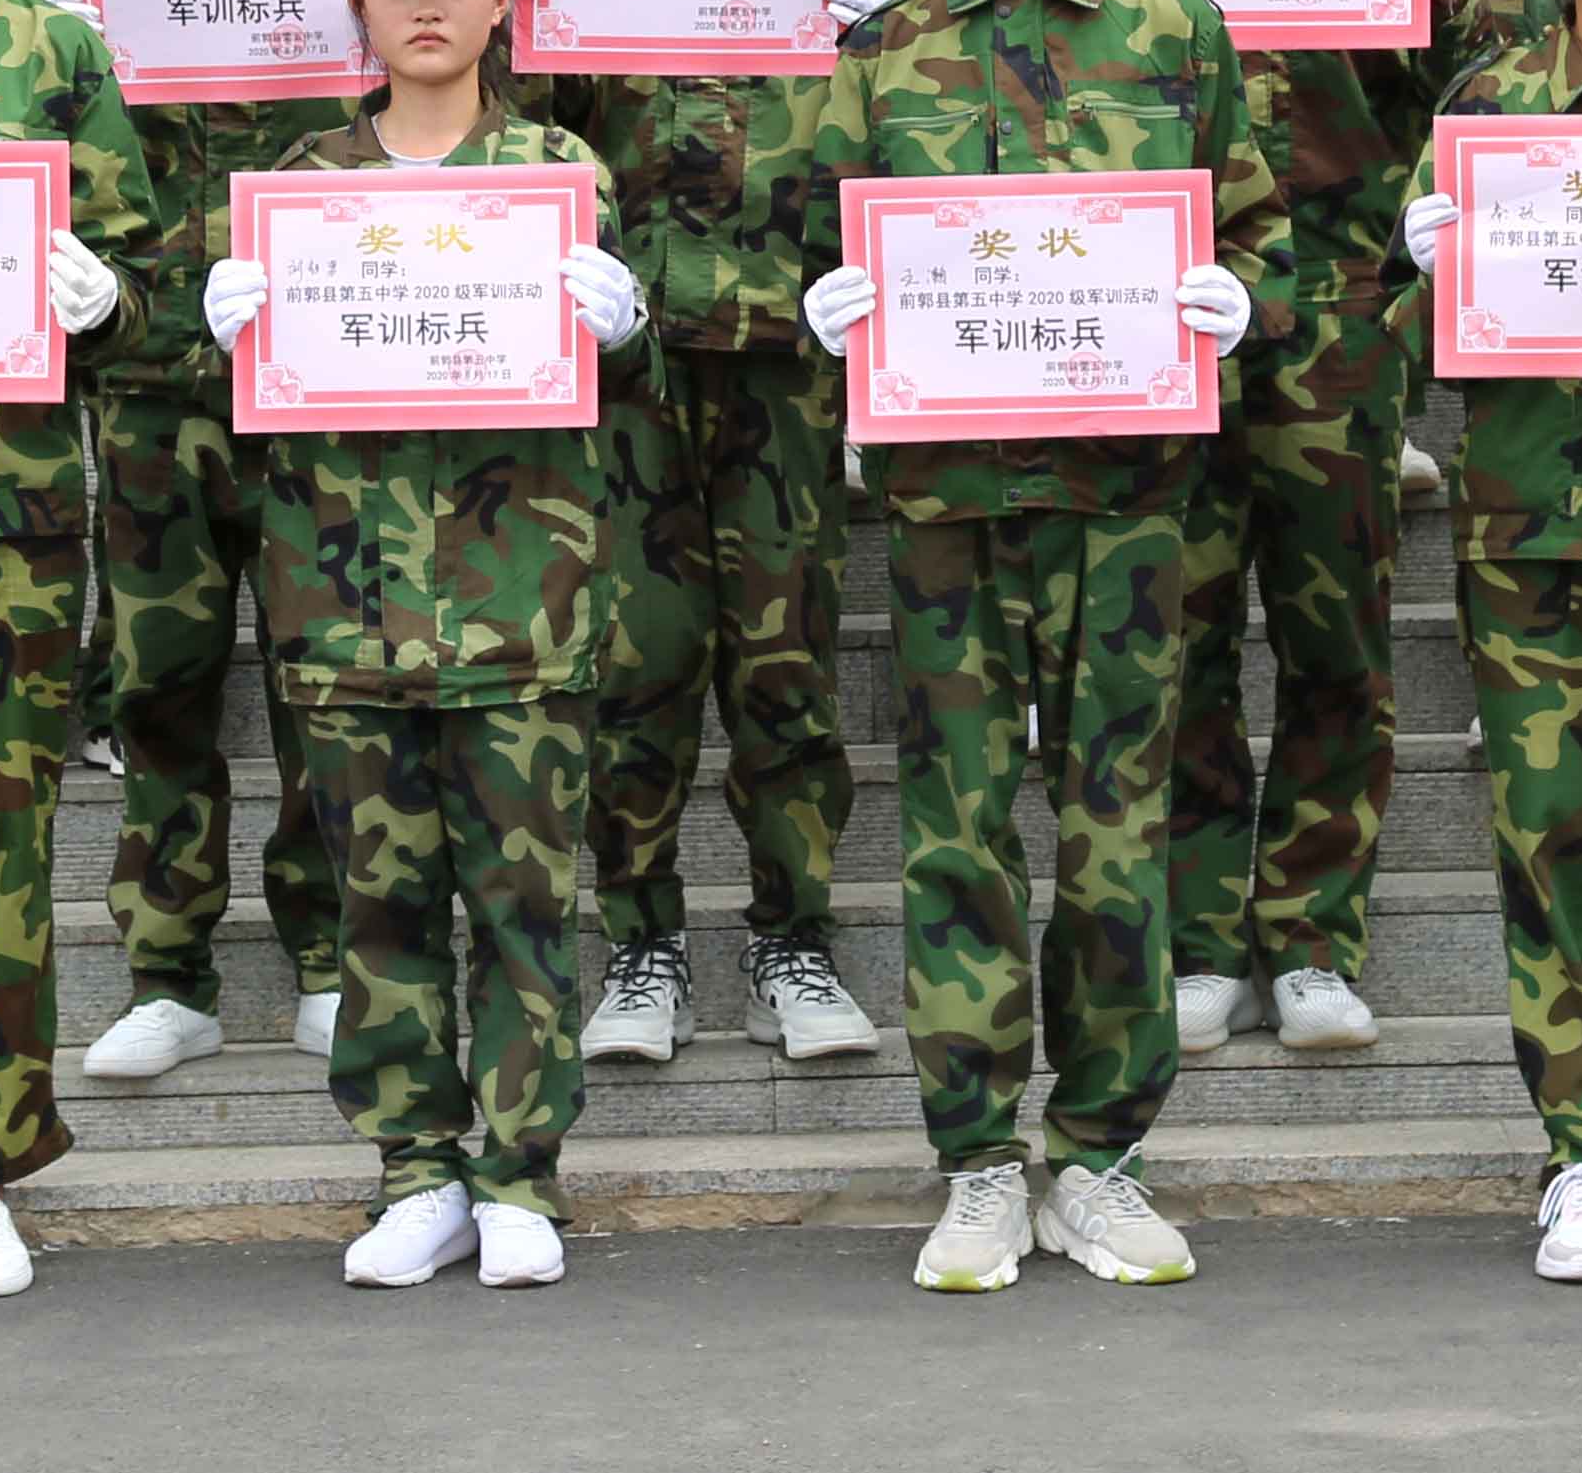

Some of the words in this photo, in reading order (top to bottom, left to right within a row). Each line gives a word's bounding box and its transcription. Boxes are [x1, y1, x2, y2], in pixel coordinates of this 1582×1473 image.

[357, 223, 474, 255] 奖状
[969, 228, 1087, 260] 奖状
[340, 311, 489, 348] 军训标兵
[955, 317, 1105, 354] 军训标兵
